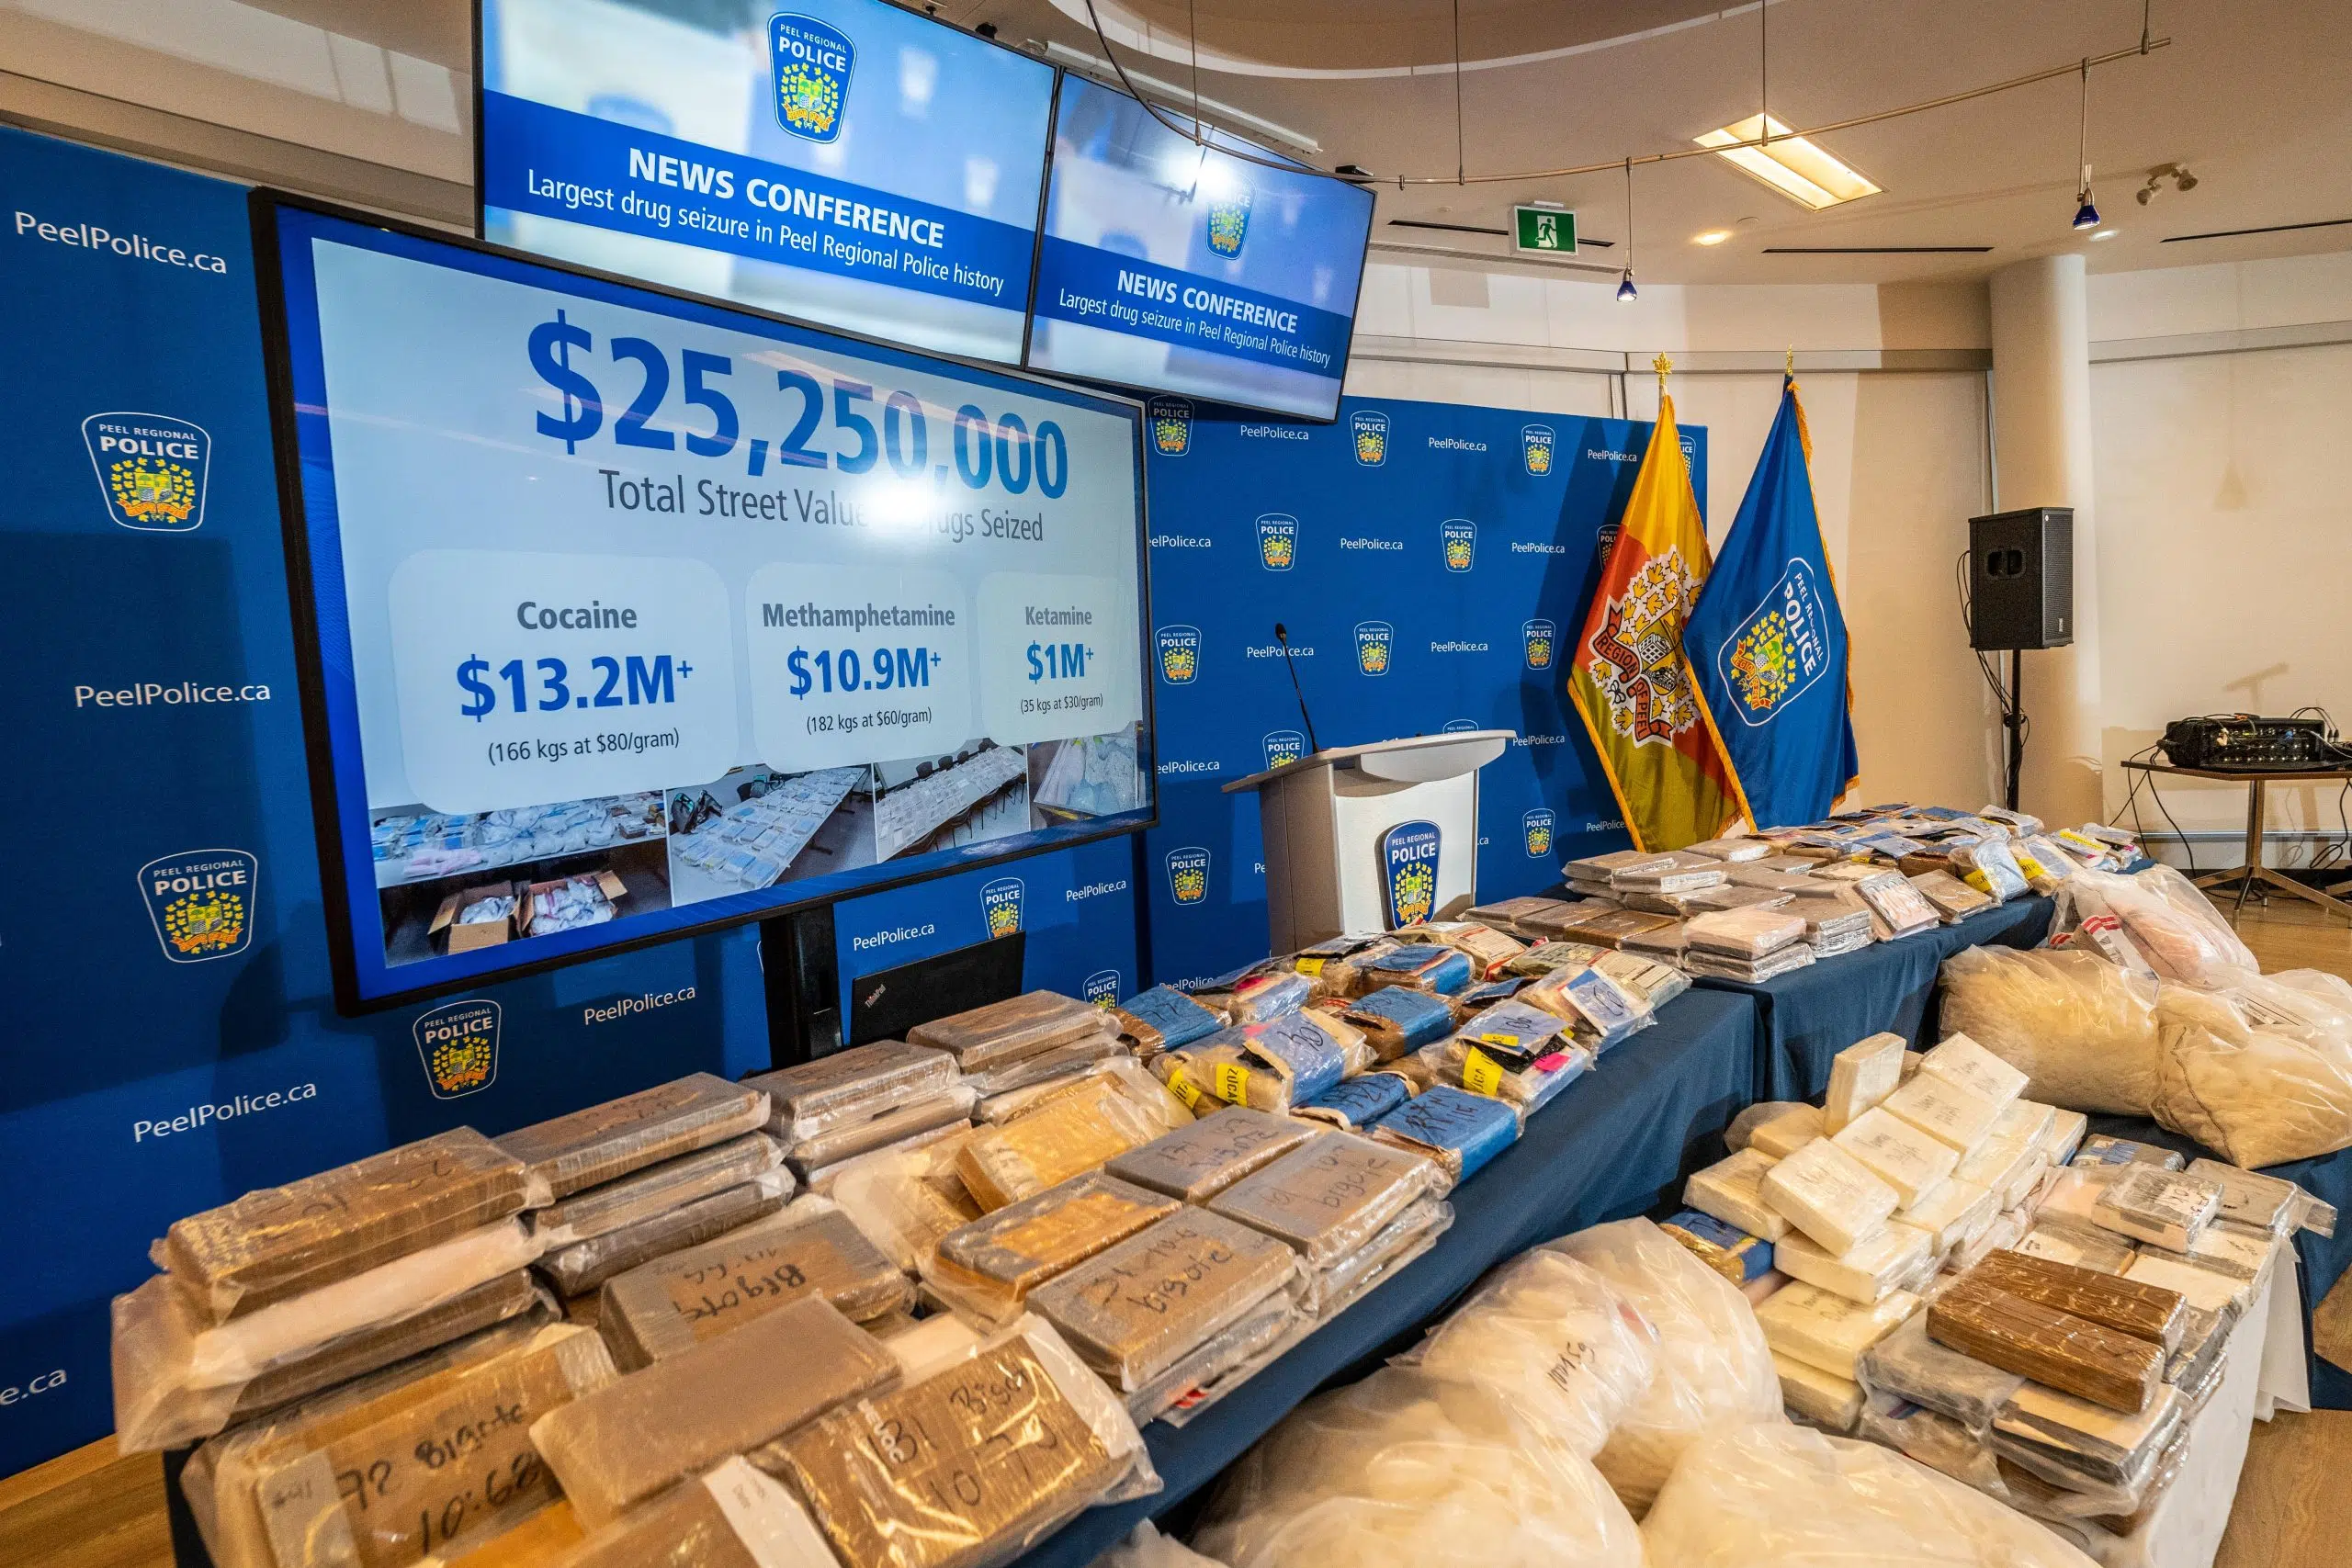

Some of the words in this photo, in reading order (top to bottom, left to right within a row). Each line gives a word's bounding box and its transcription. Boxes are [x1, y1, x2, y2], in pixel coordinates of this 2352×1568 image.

[780, 23, 799, 38] PEEL
[802, 28, 847, 53] REGIONAL
[778, 36, 846, 73] POLICE
[628, 147, 735, 199] NEWS
[746, 178, 944, 249] CONFERENCE
[15, 210, 228, 275] PeelPolice.ca
[528, 169, 614, 210] Largest
[621, 192, 672, 228] drug
[678, 208, 749, 240] seizure
[755, 219, 773, 243] in
[779, 226, 818, 254] Peel
[823, 237, 898, 271] Regional
[903, 253, 949, 281] Police
[954, 263, 1004, 297] history
[1117, 270, 1177, 303] NEWS
[1182, 288, 1298, 334] CONFERENCE
[1059, 288, 1108, 318] Largest
[1110, 299, 1138, 326] drug
[1141, 309, 1182, 333] seizure
[1184, 317, 1195, 334] in
[1199, 321, 1221, 341] Peel
[1224, 327, 1269, 354] Regional
[1270, 337, 1298, 357] Police
[1299, 344, 1331, 367] history
[526, 309, 1069, 500] $25,250,000
[1153, 407, 1190, 419] POLICE
[98, 423, 130, 436] PEEL
[133, 426, 198, 442] REGIONAL
[1240, 424, 1309, 441] PeelPolice.ca
[1354, 422, 1386, 432] POLICE
[99, 435, 199, 459] POLICE
[1429, 437, 1487, 452] PeelPolice.ca
[1525, 434, 1552, 445] POLICE
[1588, 448, 1637, 462] PeelPolice.ca
[599, 468, 685, 514] Total
[697, 479, 788, 522] Street
[793, 488, 869, 527] Value
[980, 509, 1044, 543] Seized
[1261, 525, 1295, 535] POLICE
[1444, 529, 1474, 539] POLICE
[1149, 535, 1212, 547] elPolice.ca
[1340, 537, 1403, 550] PeelPolice.ca
[1511, 542, 1565, 554] PeelPolice.ca
[1794, 571, 1809, 603] PEEL
[516, 601, 638, 631] Cocaine
[763, 603, 956, 633] Methamphetamine
[1024, 606, 1093, 626] Ketamine
[1359, 632, 1389, 641] POLICE
[1526, 629, 1552, 638] POLICE
[1784, 581, 1816, 677] POLICE
[1160, 637, 1196, 648] POLICE
[1247, 646, 1314, 659] PeelPolce.ca
[1430, 641, 1488, 653] PeelPolice.ca
[1026, 642, 1094, 685] $1M+
[1597, 636, 1639, 677] REGION
[786, 647, 942, 701] $10.9M+
[74, 682, 271, 708] PeelPolice.ca
[456, 653, 694, 723] $13.2M+
[1636, 679, 1648, 697] OF
[1020, 698, 1035, 715] (35
[1036, 696, 1051, 714] kgs
[1054, 697, 1063, 710] at
[1064, 693, 1103, 712] $30/gram)
[806, 714, 833, 735] (182
[837, 711, 859, 733] kgs
[861, 711, 875, 727] at
[876, 705, 933, 729] $60/gram)
[1636, 700, 1649, 739] PEEL
[488, 739, 531, 766] (166
[537, 736, 569, 762] kgs
[573, 738, 593, 757] at
[596, 728, 680, 755] $80/gram)
[1268, 741, 1300, 752] POLICE
[1512, 734, 1565, 747] PeelPolice.ca
[1157, 761, 1220, 774] eelPolice.ca
[1526, 818, 1553, 828] POLICE
[1587, 819, 1626, 832] PeelPolice.
[1392, 838, 1406, 846] PEEL
[1407, 831, 1436, 842] REGIONAL
[1392, 842, 1436, 864] POLICE
[153, 866, 182, 878] PEEL
[186, 859, 245, 874] REGIONAL
[1171, 859, 1206, 870] POLICE
[153, 870, 247, 896] POLICE
[1066, 878, 1126, 902] PeelPolice.ca
[986, 890, 1021, 905] POLICE
[854, 923, 935, 952] PeelPolice.ca
[1088, 980, 1117, 997] POLICE
[583, 985, 696, 1026] PeelPolice.ca
[424, 1018, 445, 1028] PEEL
[447, 1008, 492, 1023] REGIONAL
[424, 1017, 493, 1044] POLICE
[133, 1082, 318, 1143] PeelPolice.ca
